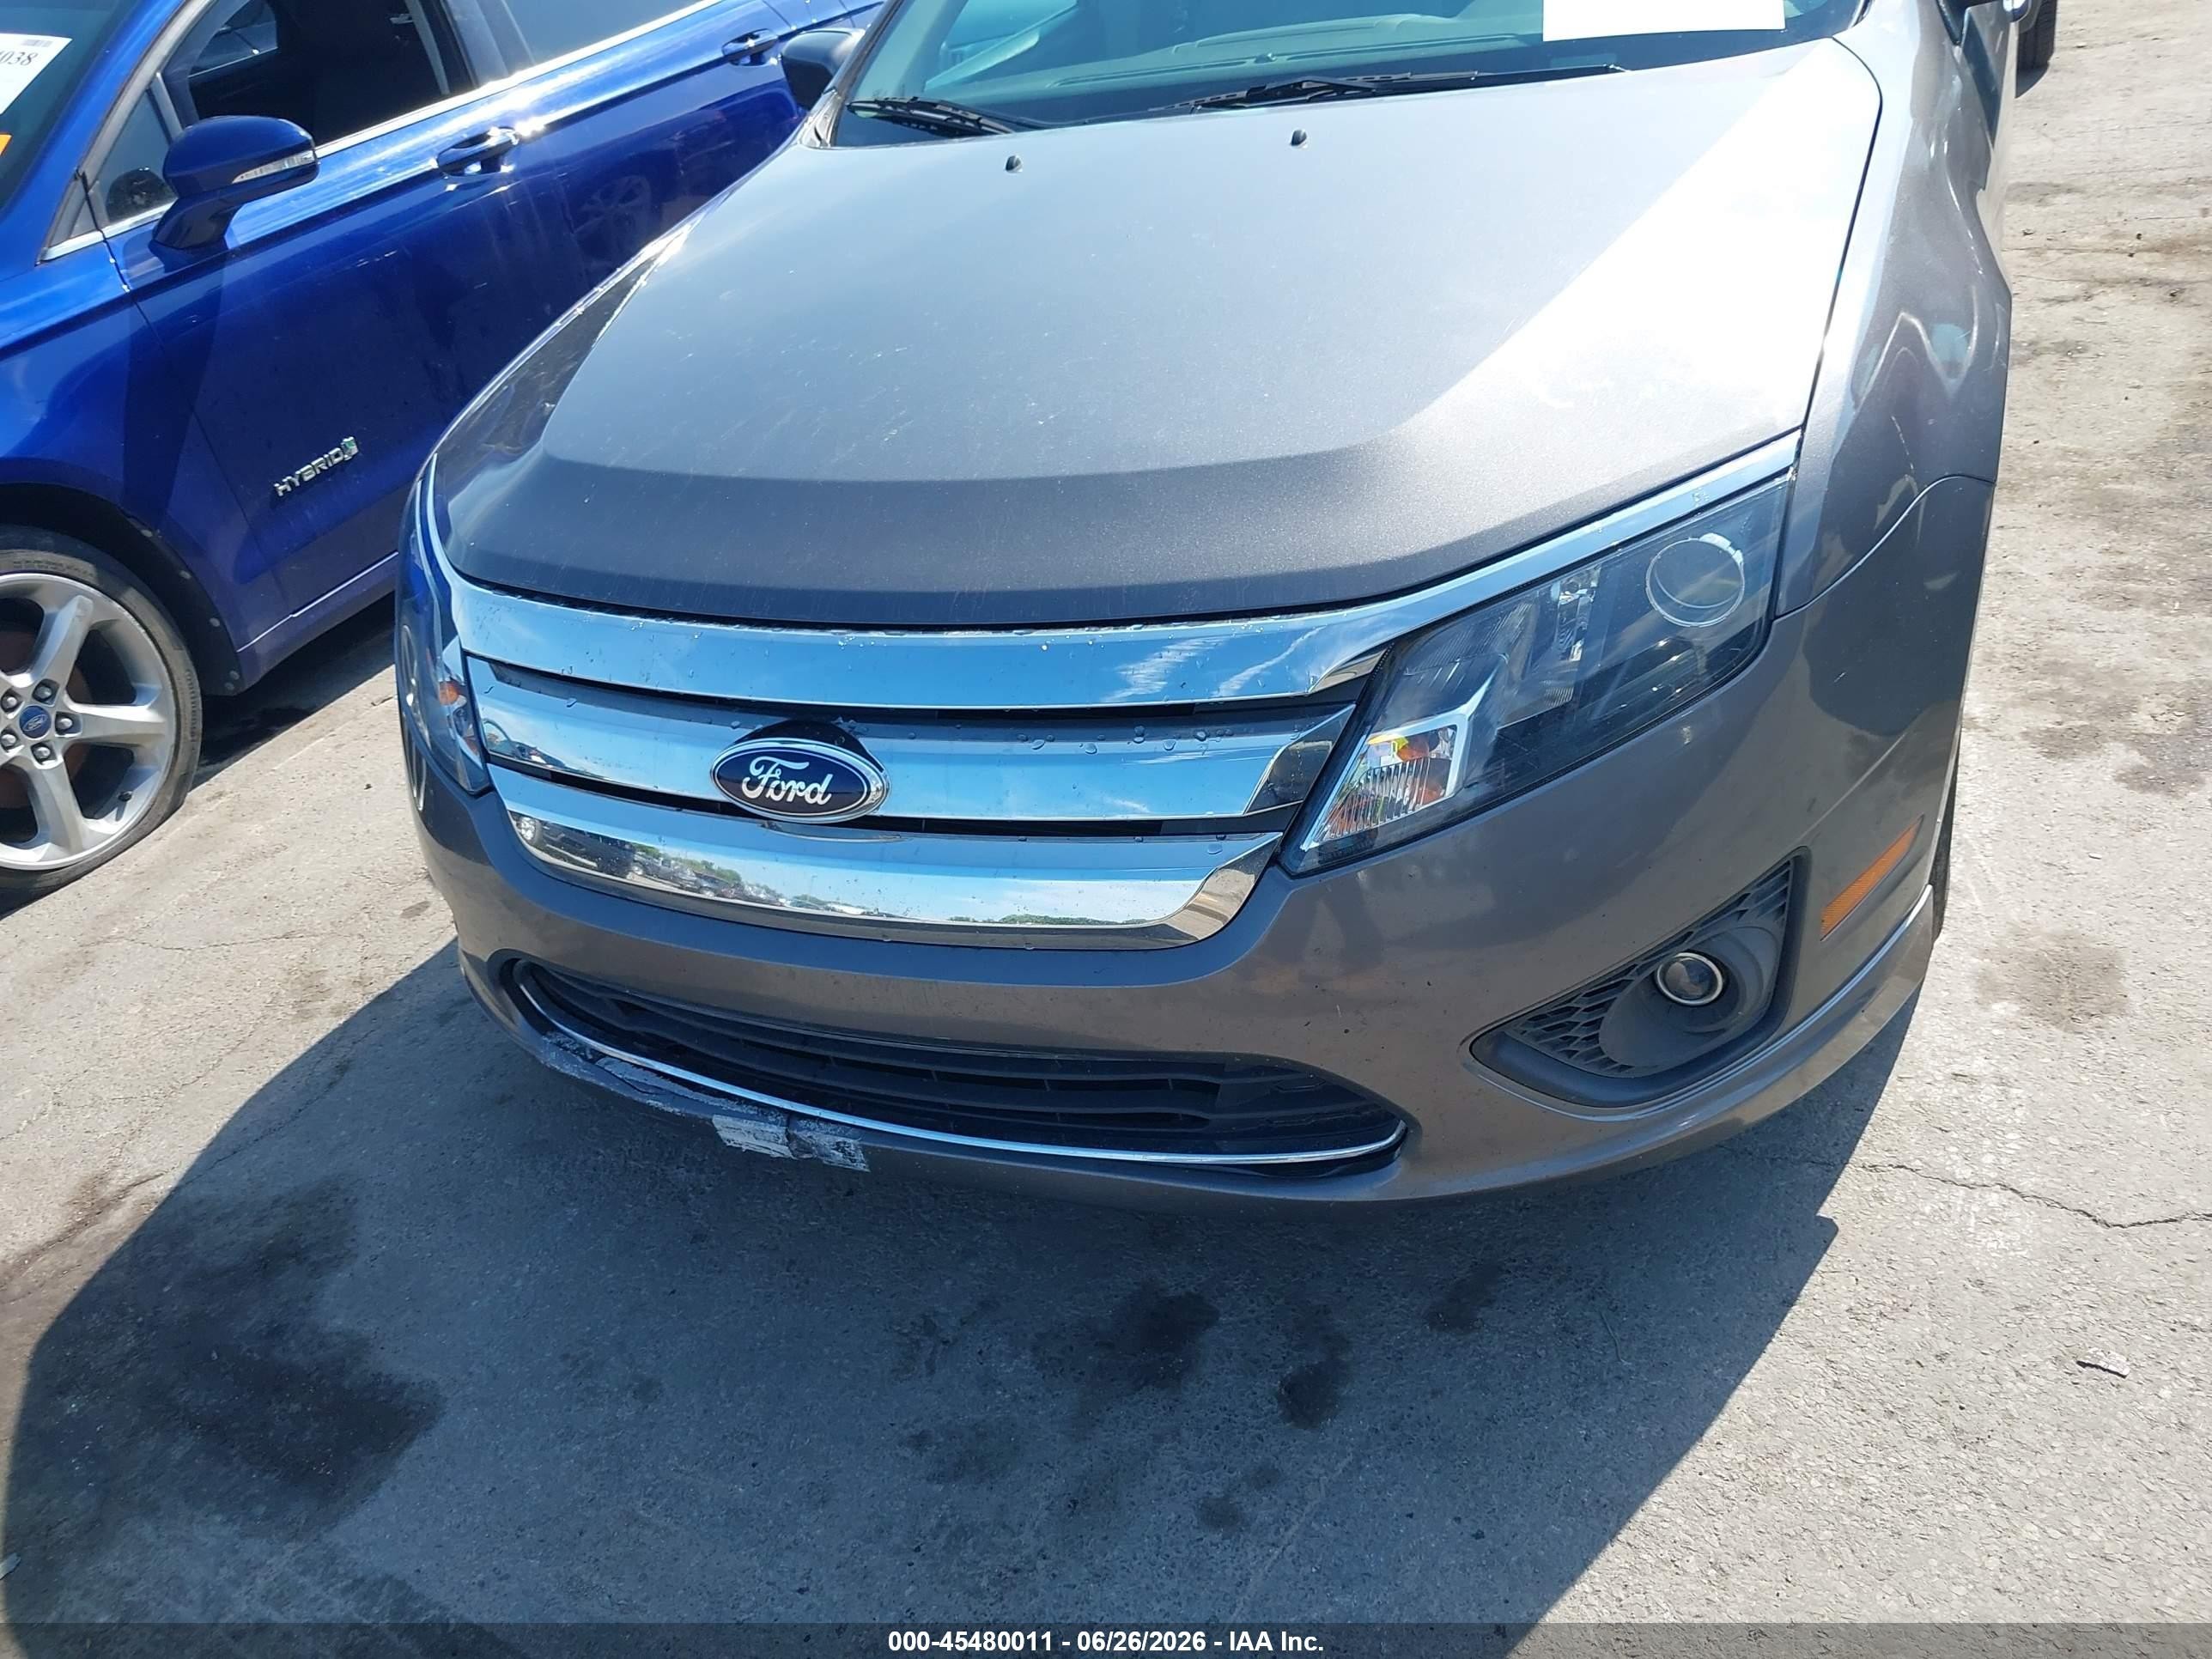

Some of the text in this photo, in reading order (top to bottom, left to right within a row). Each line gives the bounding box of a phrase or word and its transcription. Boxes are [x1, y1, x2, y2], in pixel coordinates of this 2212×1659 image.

[0, 50, 40, 66] 038
[273, 447, 344, 497] HYBRID
[741, 756, 834, 805] Ford
